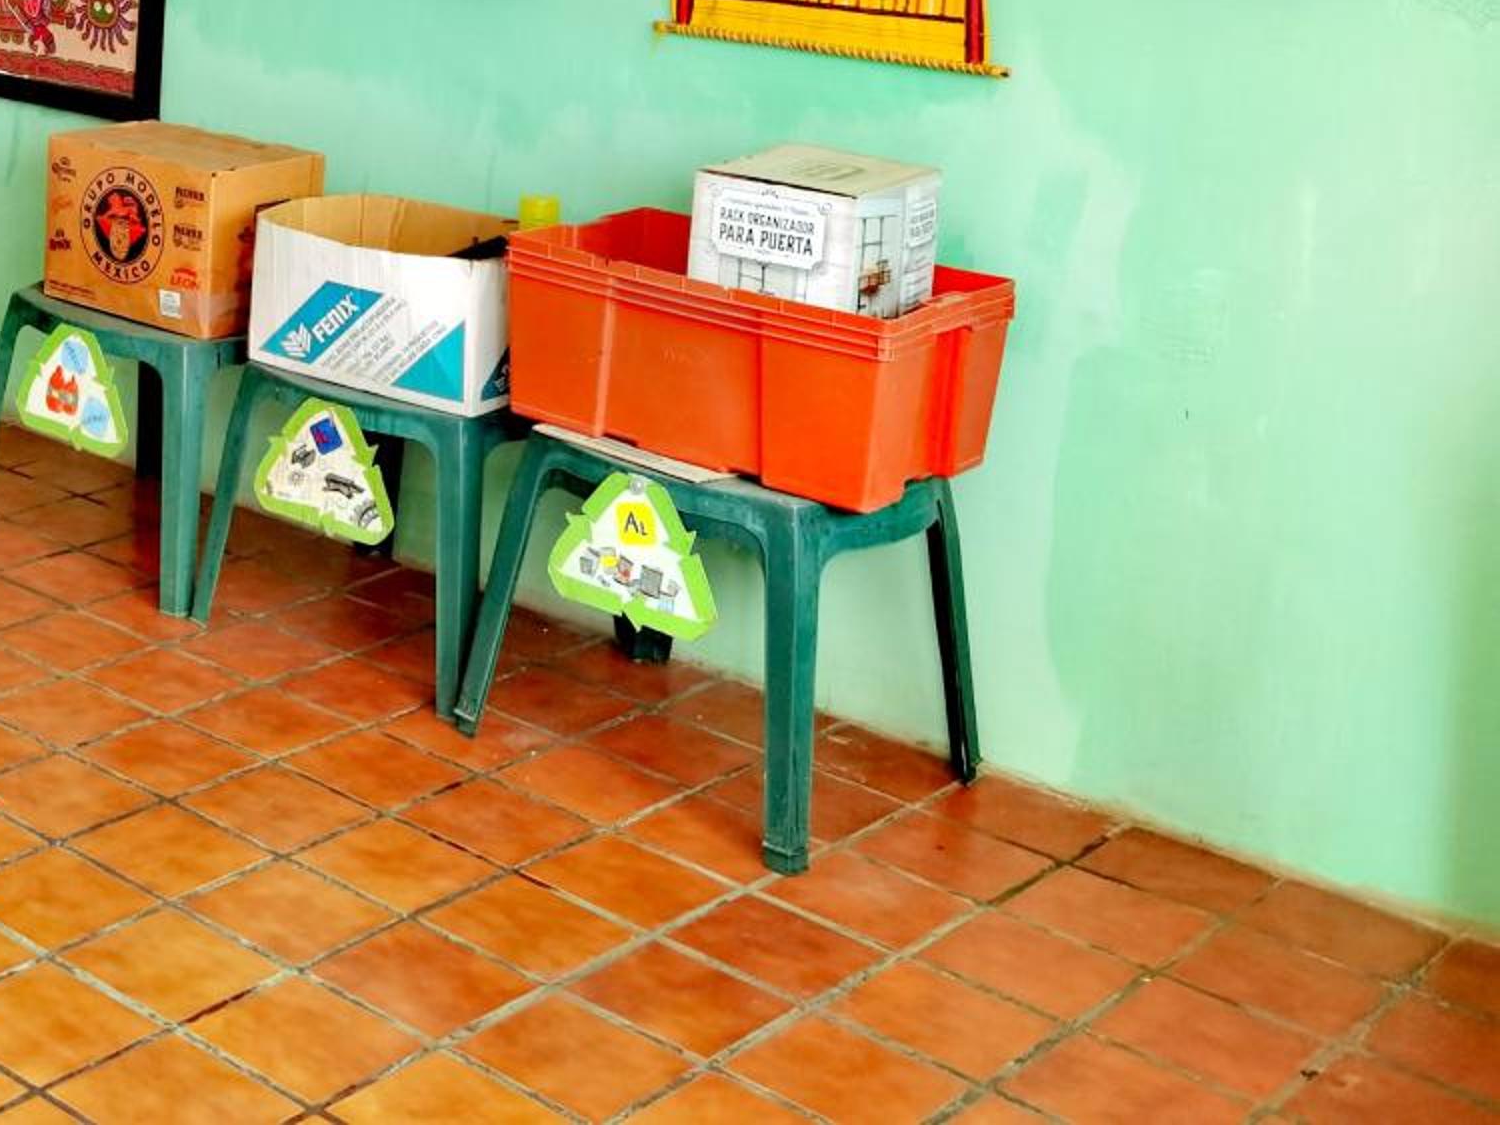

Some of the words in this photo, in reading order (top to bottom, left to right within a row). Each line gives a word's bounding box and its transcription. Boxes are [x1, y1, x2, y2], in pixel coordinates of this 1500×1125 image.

[82, 172, 115, 230] GRUPO
[126, 173, 162, 247] MODELO
[719, 205, 745, 225] RACK
[747, 211, 815, 236] ORGANIZADOR
[718, 222, 755, 244] PARA
[760, 229, 814, 256] PUERTA
